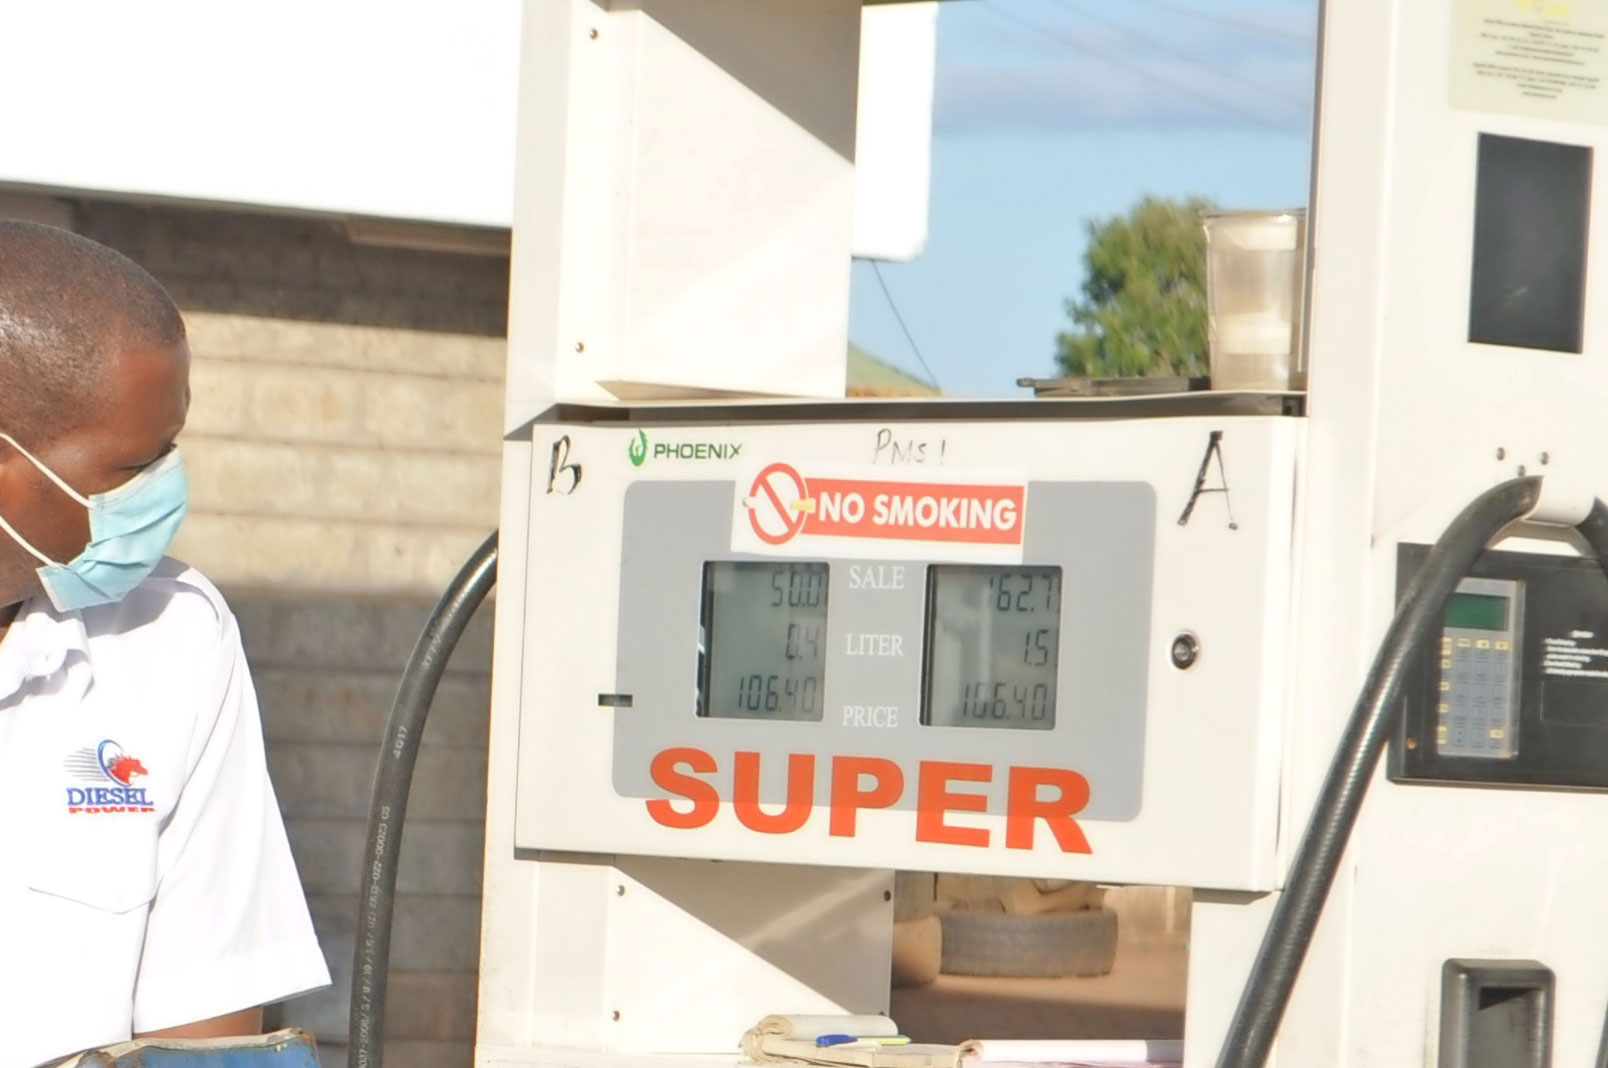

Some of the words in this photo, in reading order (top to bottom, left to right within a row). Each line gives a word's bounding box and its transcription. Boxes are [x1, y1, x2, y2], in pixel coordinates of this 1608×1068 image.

[653, 443, 743, 461] PHOENIX
[1177, 430, 1240, 530] A
[819, 492, 865, 524] NO
[872, 495, 1018, 530] SMOKING
[849, 565, 906, 591] SALE
[845, 633, 905, 657] LITER
[842, 705, 899, 729] PRICE
[65, 787, 155, 807] DIESEL
[645, 745, 1094, 856] SUPER
